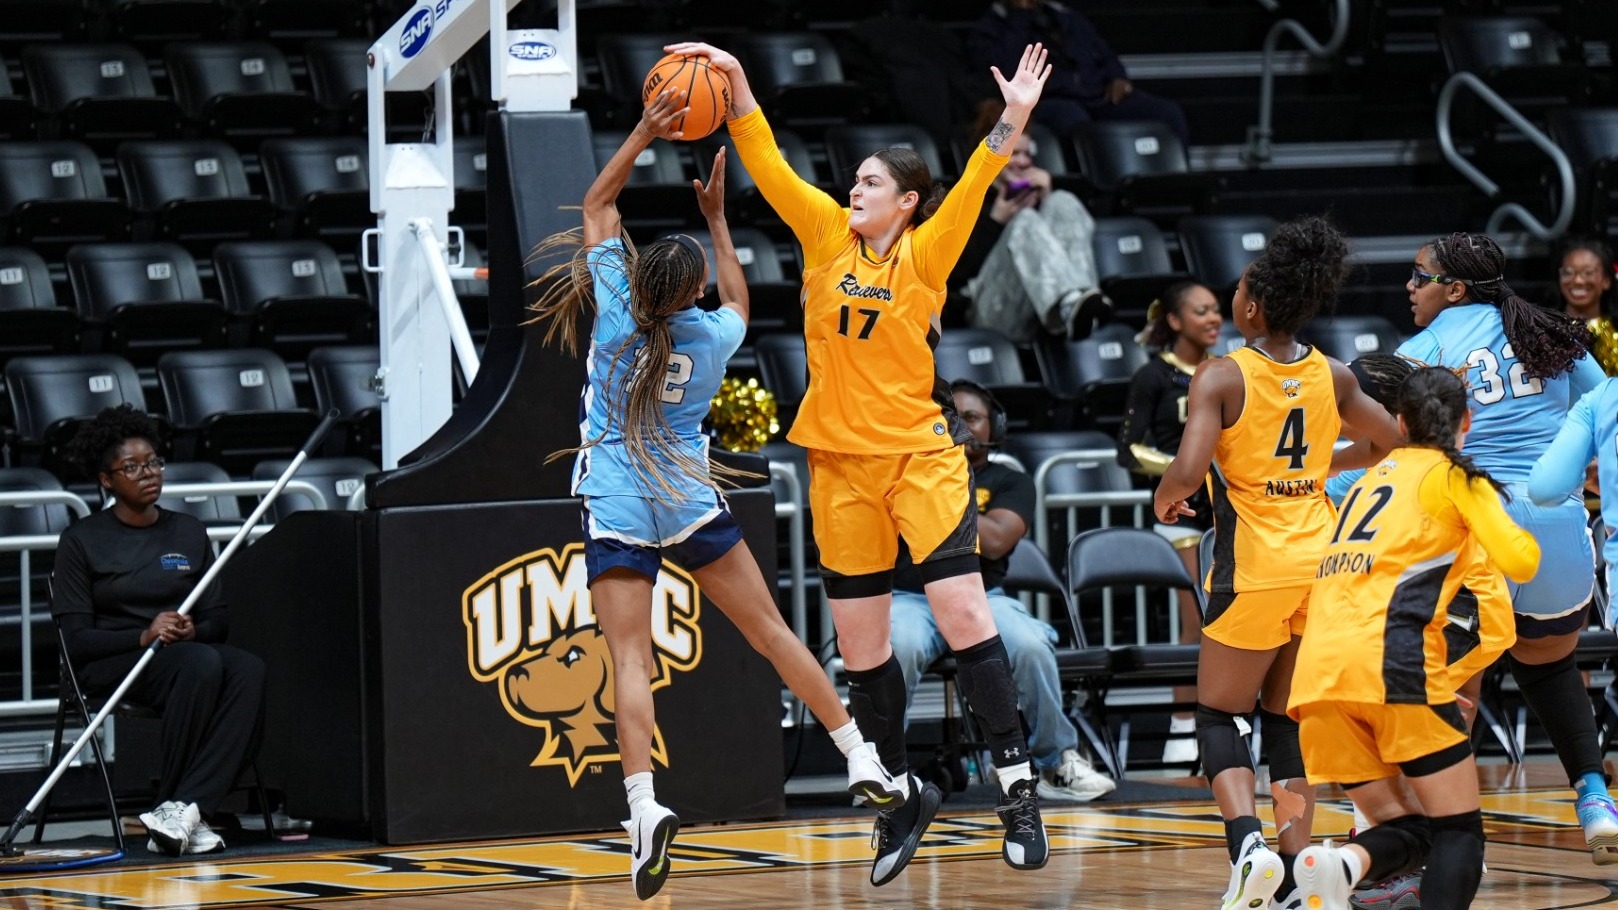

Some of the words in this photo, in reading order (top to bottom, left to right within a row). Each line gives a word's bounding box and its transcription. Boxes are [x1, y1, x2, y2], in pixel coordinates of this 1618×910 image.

[5, 270, 17, 281] 11
[153, 265, 167, 277] 12
[837, 305, 880, 340] 17
[95, 378, 107, 389] 11
[246, 373, 259, 383] 12
[1466, 342, 1544, 406] 32
[1274, 407, 1309, 470] 4
[1265, 479, 1318, 496] AUSTIN
[1330, 485, 1393, 545] 12
[1315, 551, 1376, 579] HOMPSON
[472, 553, 692, 671] UMC
[589, 765, 602, 774] TM
